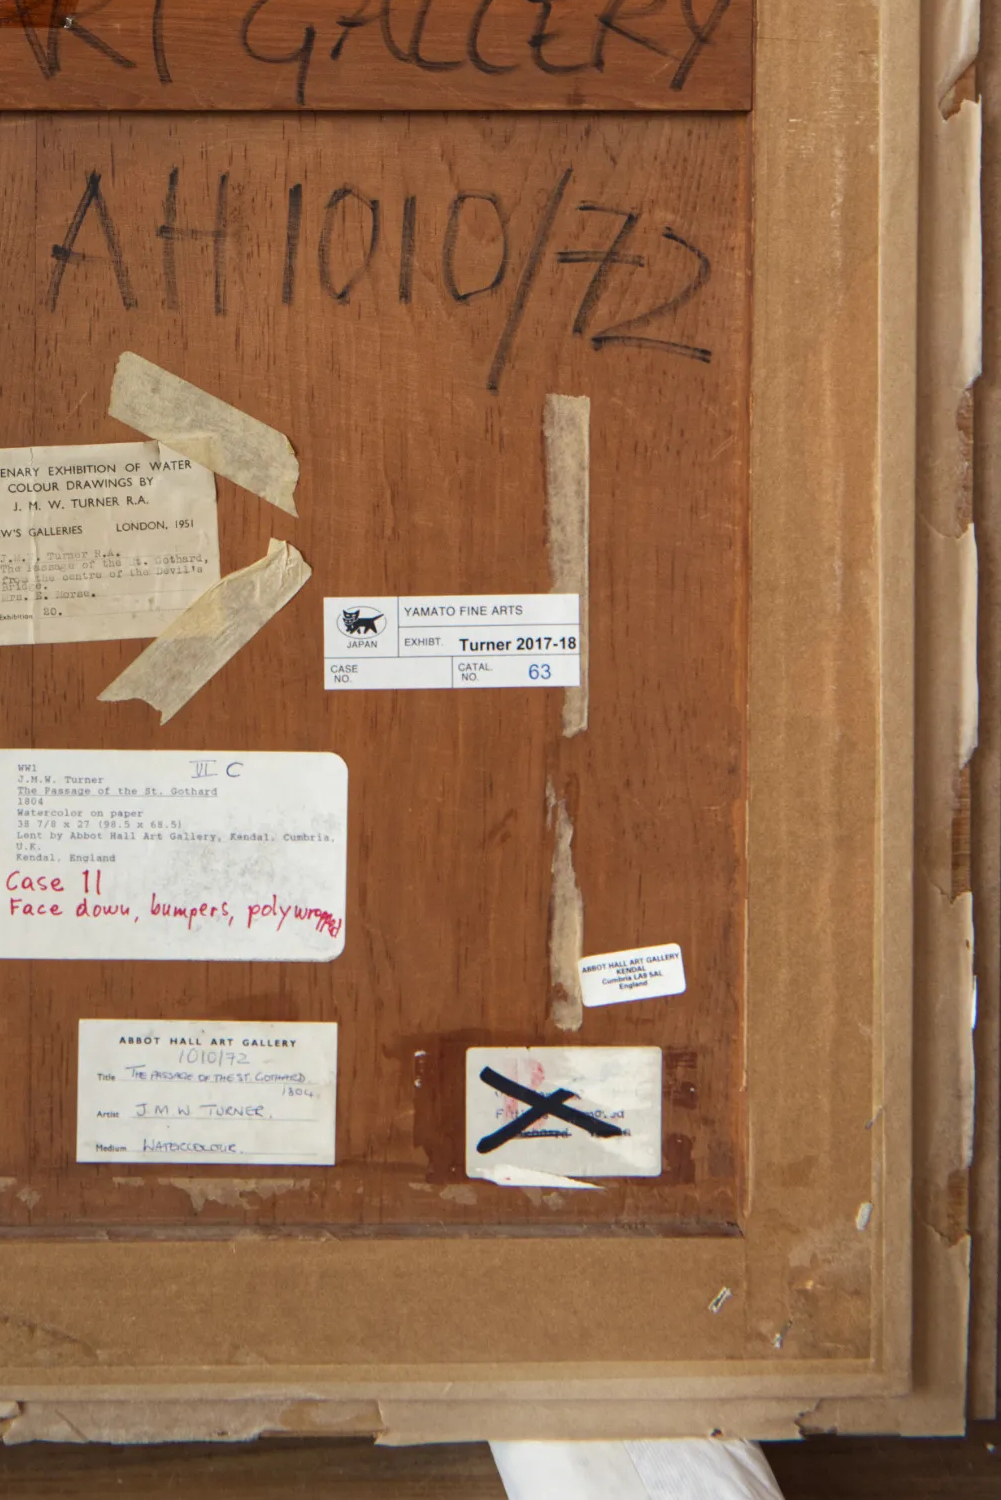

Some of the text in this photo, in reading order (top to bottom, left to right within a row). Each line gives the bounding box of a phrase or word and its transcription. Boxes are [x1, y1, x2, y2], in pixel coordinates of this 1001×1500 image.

[48, 463, 117, 476] EXHIBITION
[125, 462, 141, 473] OF
[150, 459, 192, 472] WATER
[8, 476, 155, 494] COLOUR DRAWINGS BY
[28, 525, 83, 538] GALLERIES
[116, 519, 194, 533] LONDON, 1951
[404, 605, 523, 617] YAMATO FINE ARTS
[346, 640, 377, 649] JAPAN
[404, 637, 577, 652] EXHIBT. Turner 2017-18
[330, 665, 358, 674] CASE
[458, 662, 493, 672] CATAL.
[528, 663, 551, 679] 63
[334, 674, 352, 683] NO.
[462, 672, 479, 681] NO.
[226, 761, 244, 778] C
[5, 870, 64, 893] Case
[9, 898, 63, 916] Face
[76, 898, 139, 923] down,
[150, 893, 234, 929] bumpers,
[119, 1037, 297, 1048] ABBOT HALL ART GALLERY
